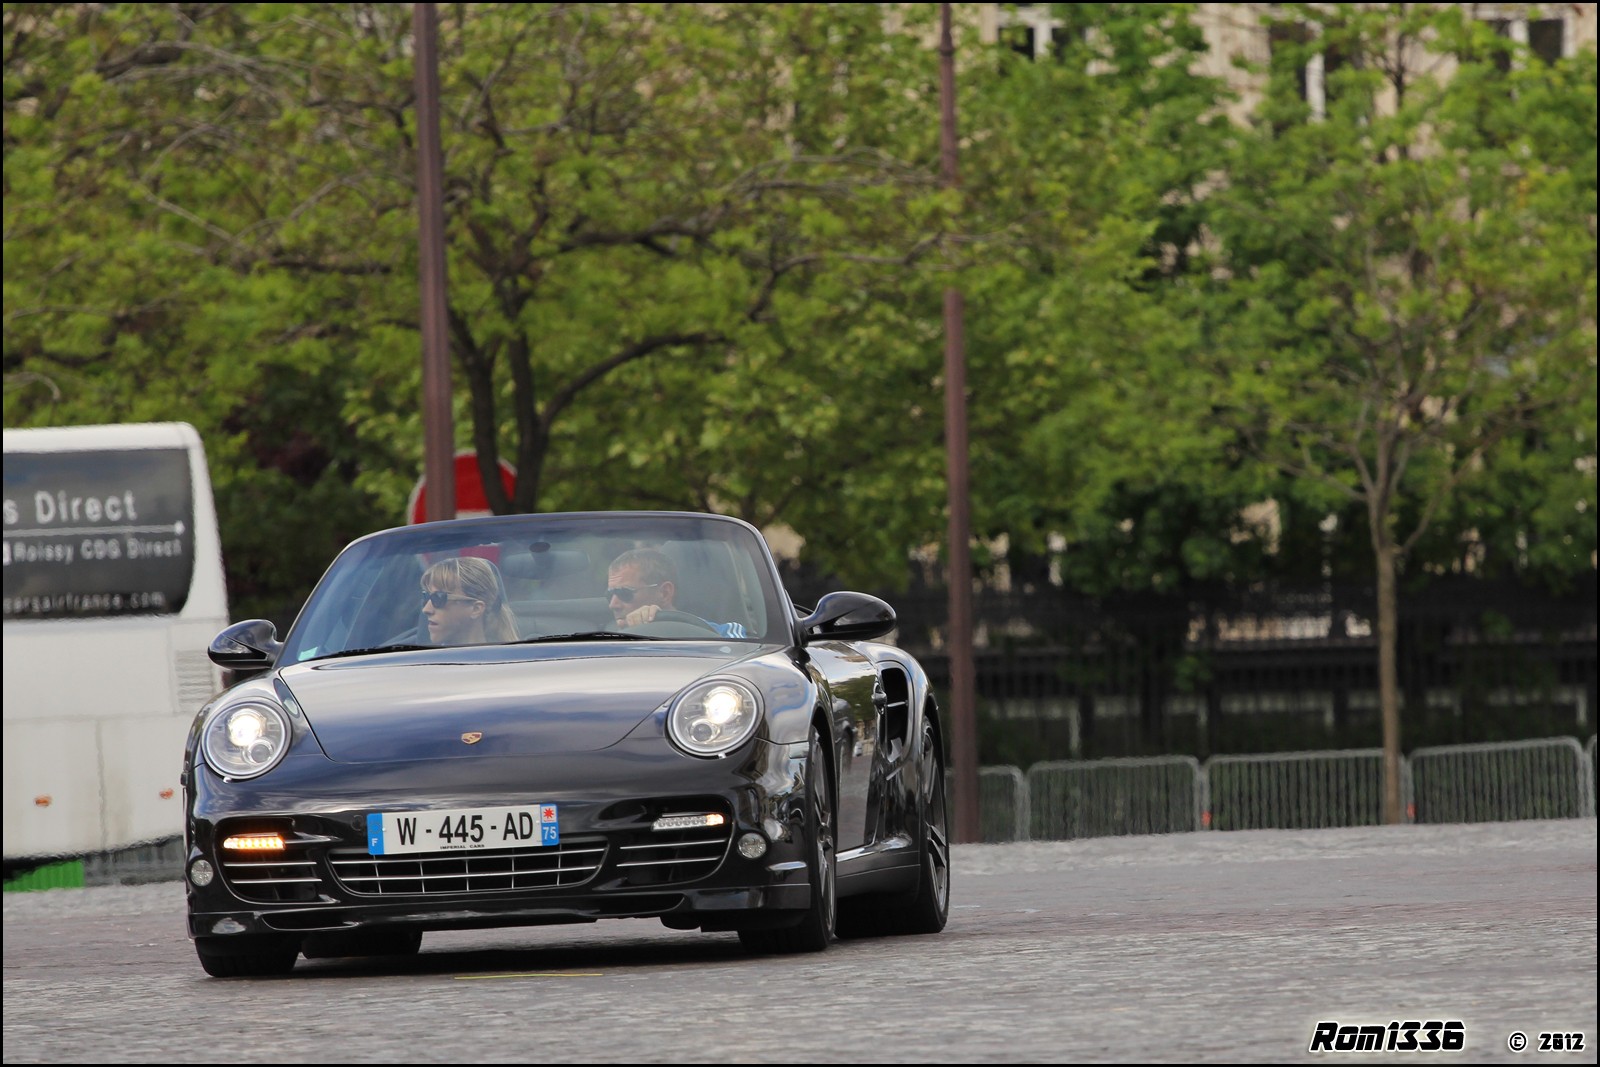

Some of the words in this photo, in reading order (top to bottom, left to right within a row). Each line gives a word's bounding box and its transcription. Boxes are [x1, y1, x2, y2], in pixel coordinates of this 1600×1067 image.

[34, 490, 138, 524] Direct
[13, 541, 74, 565] Roissy
[126, 538, 182, 559] Direct
[396, 817, 417, 846] W
[438, 814, 484, 844] 445
[502, 811, 534, 841] AD
[542, 826, 557, 840] 75
[371, 838, 378, 847] F
